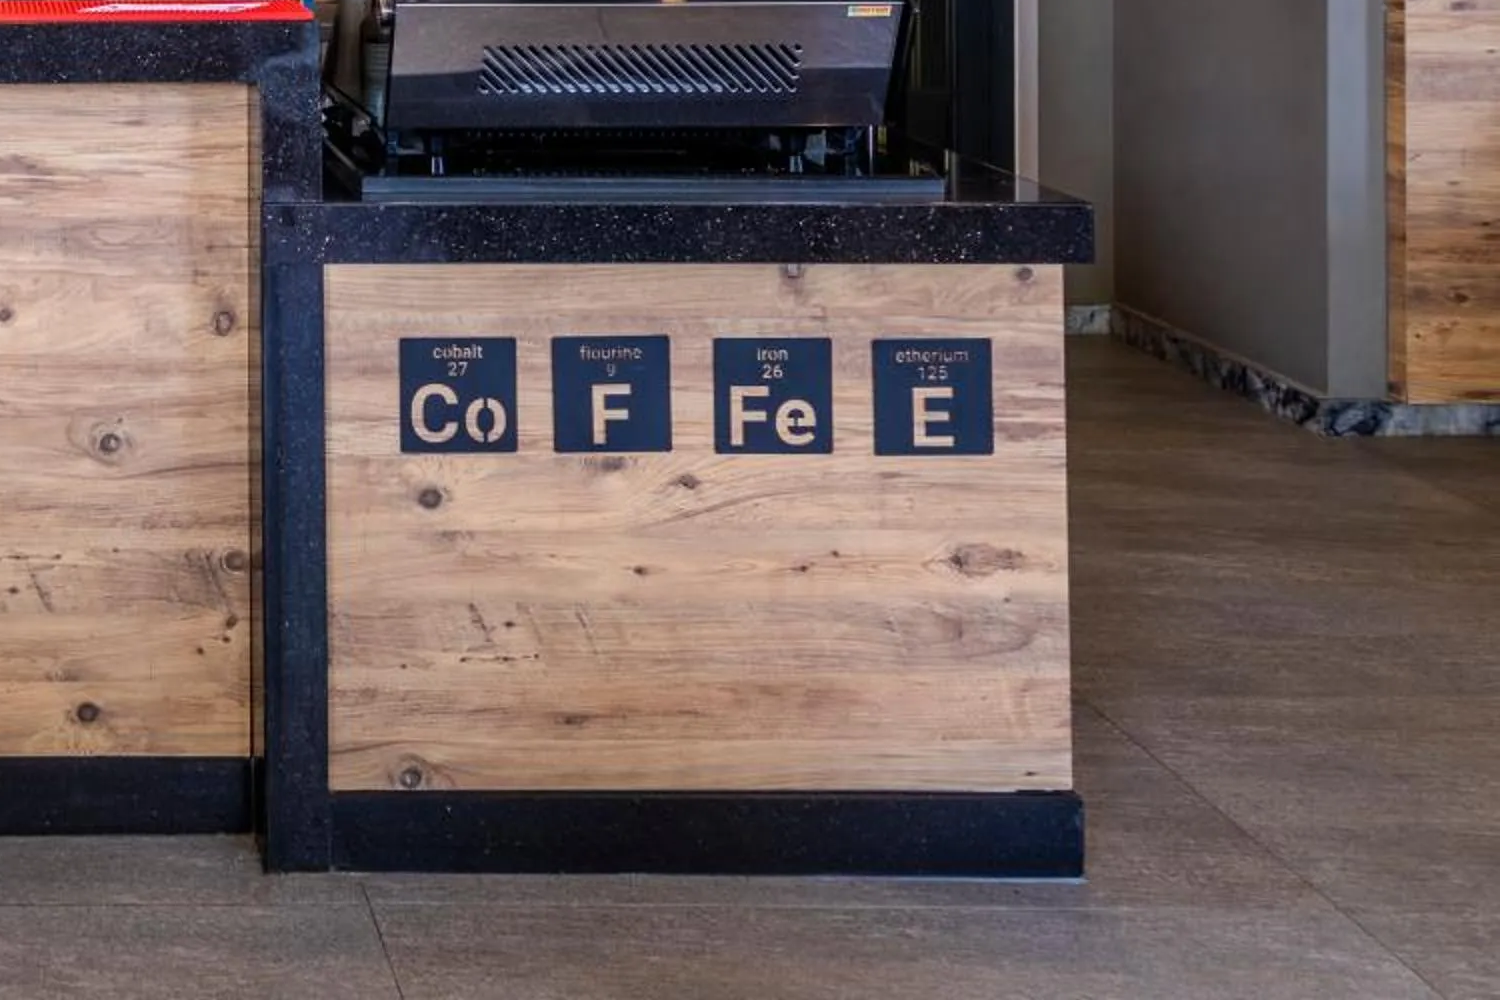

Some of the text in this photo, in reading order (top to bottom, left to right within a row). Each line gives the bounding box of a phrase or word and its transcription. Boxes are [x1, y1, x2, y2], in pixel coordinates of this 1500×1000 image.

[432, 344, 483, 359] cobalt
[895, 349, 969, 362] etherium
[447, 361, 468, 376] 27
[606, 364, 616, 377] 9
[761, 364, 784, 379] 26
[918, 366, 948, 380] 125
[411, 383, 507, 443] Co
[591, 383, 632, 445] F
[729, 385, 817, 446] Fe
[911, 386, 955, 447] E
